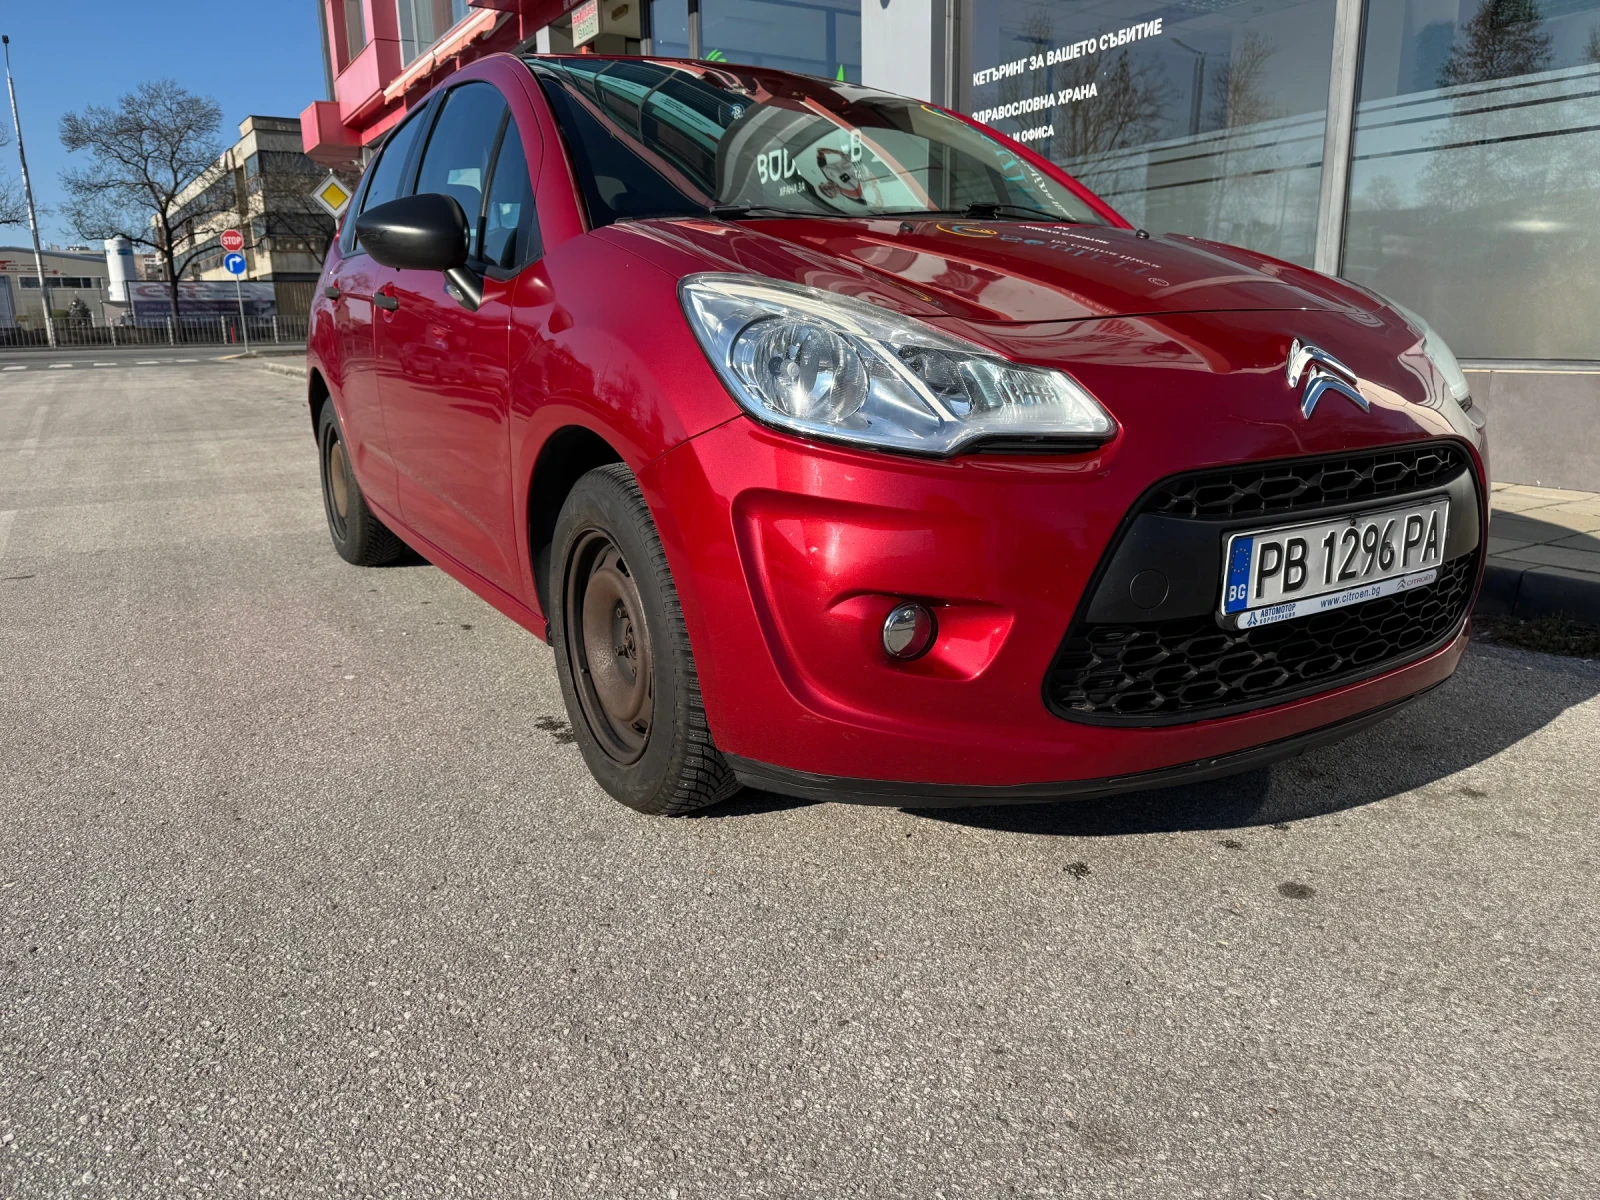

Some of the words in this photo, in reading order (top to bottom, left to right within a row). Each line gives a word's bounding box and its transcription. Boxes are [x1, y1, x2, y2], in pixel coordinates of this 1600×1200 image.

[973, 58, 1027, 87] КЕТЪРИНГ
[1029, 55, 1044, 71] ЗА
[1046, 38, 1097, 66] ВАШЕТО
[1099, 17, 1162, 50] СЪБИТИЕ
[972, 94, 1056, 124] ЗДРАВОСЛОВНА
[1058, 82, 1098, 105] ХРАНА
[1021, 124, 1054, 143] ОФИСА
[223, 236, 241, 245] STOP
[1254, 536, 1308, 599] PB
[1322, 518, 1395, 585] 1296
[1400, 510, 1438, 568] PA
[1229, 584, 1246, 601] BG
[1320, 586, 1381, 608] www.citroen.bg
[1260, 603, 1297, 618] АВТОМОТОР
